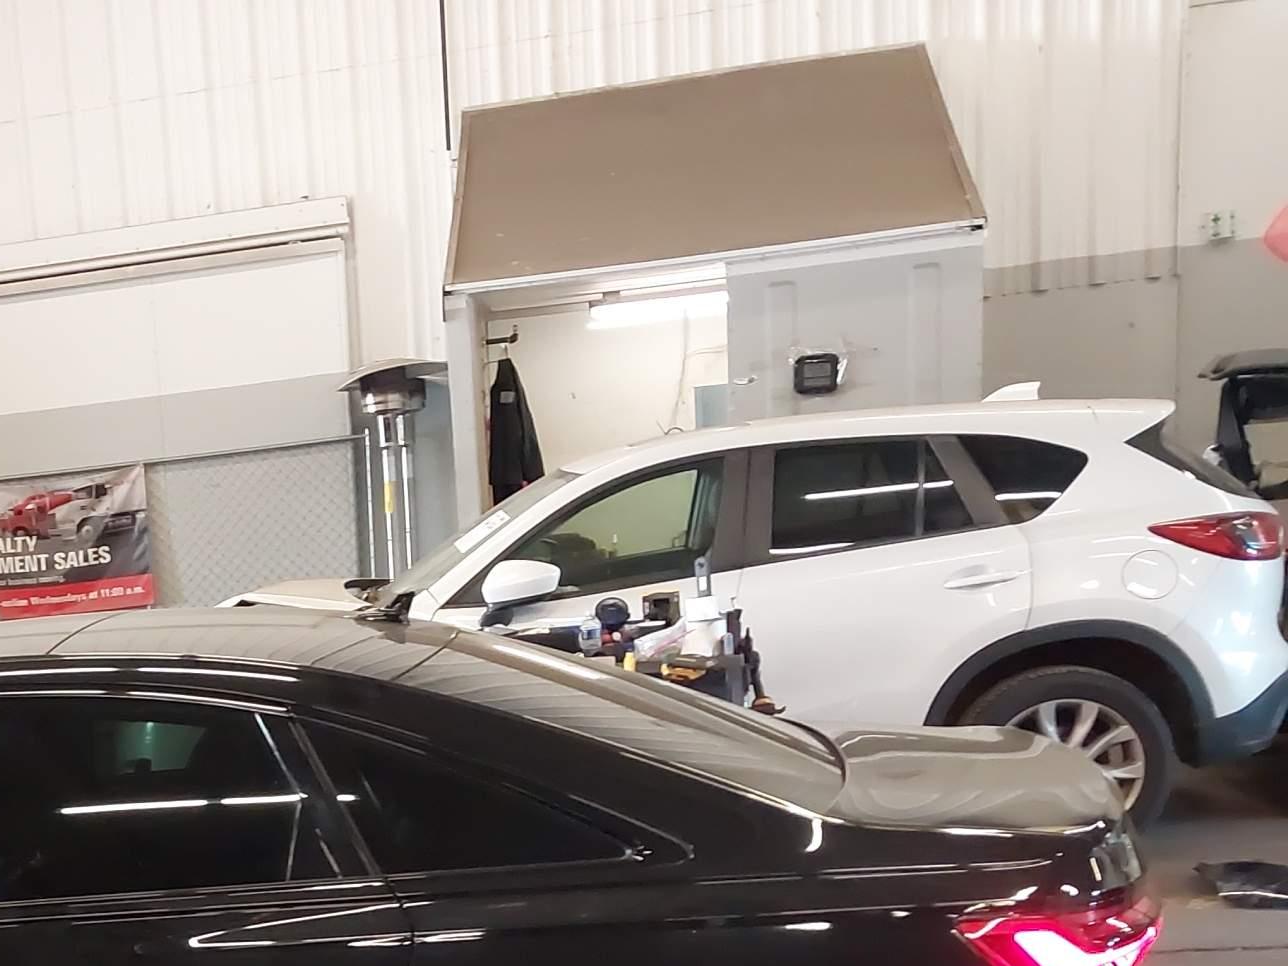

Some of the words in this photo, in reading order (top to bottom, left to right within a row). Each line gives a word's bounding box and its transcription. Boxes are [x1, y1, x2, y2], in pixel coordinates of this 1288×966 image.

[54, 545, 112, 571] SALES
[30, 593, 87, 606] Wednesdays
[88, 591, 99, 600] at
[126, 586, 145, 596] a.m.
